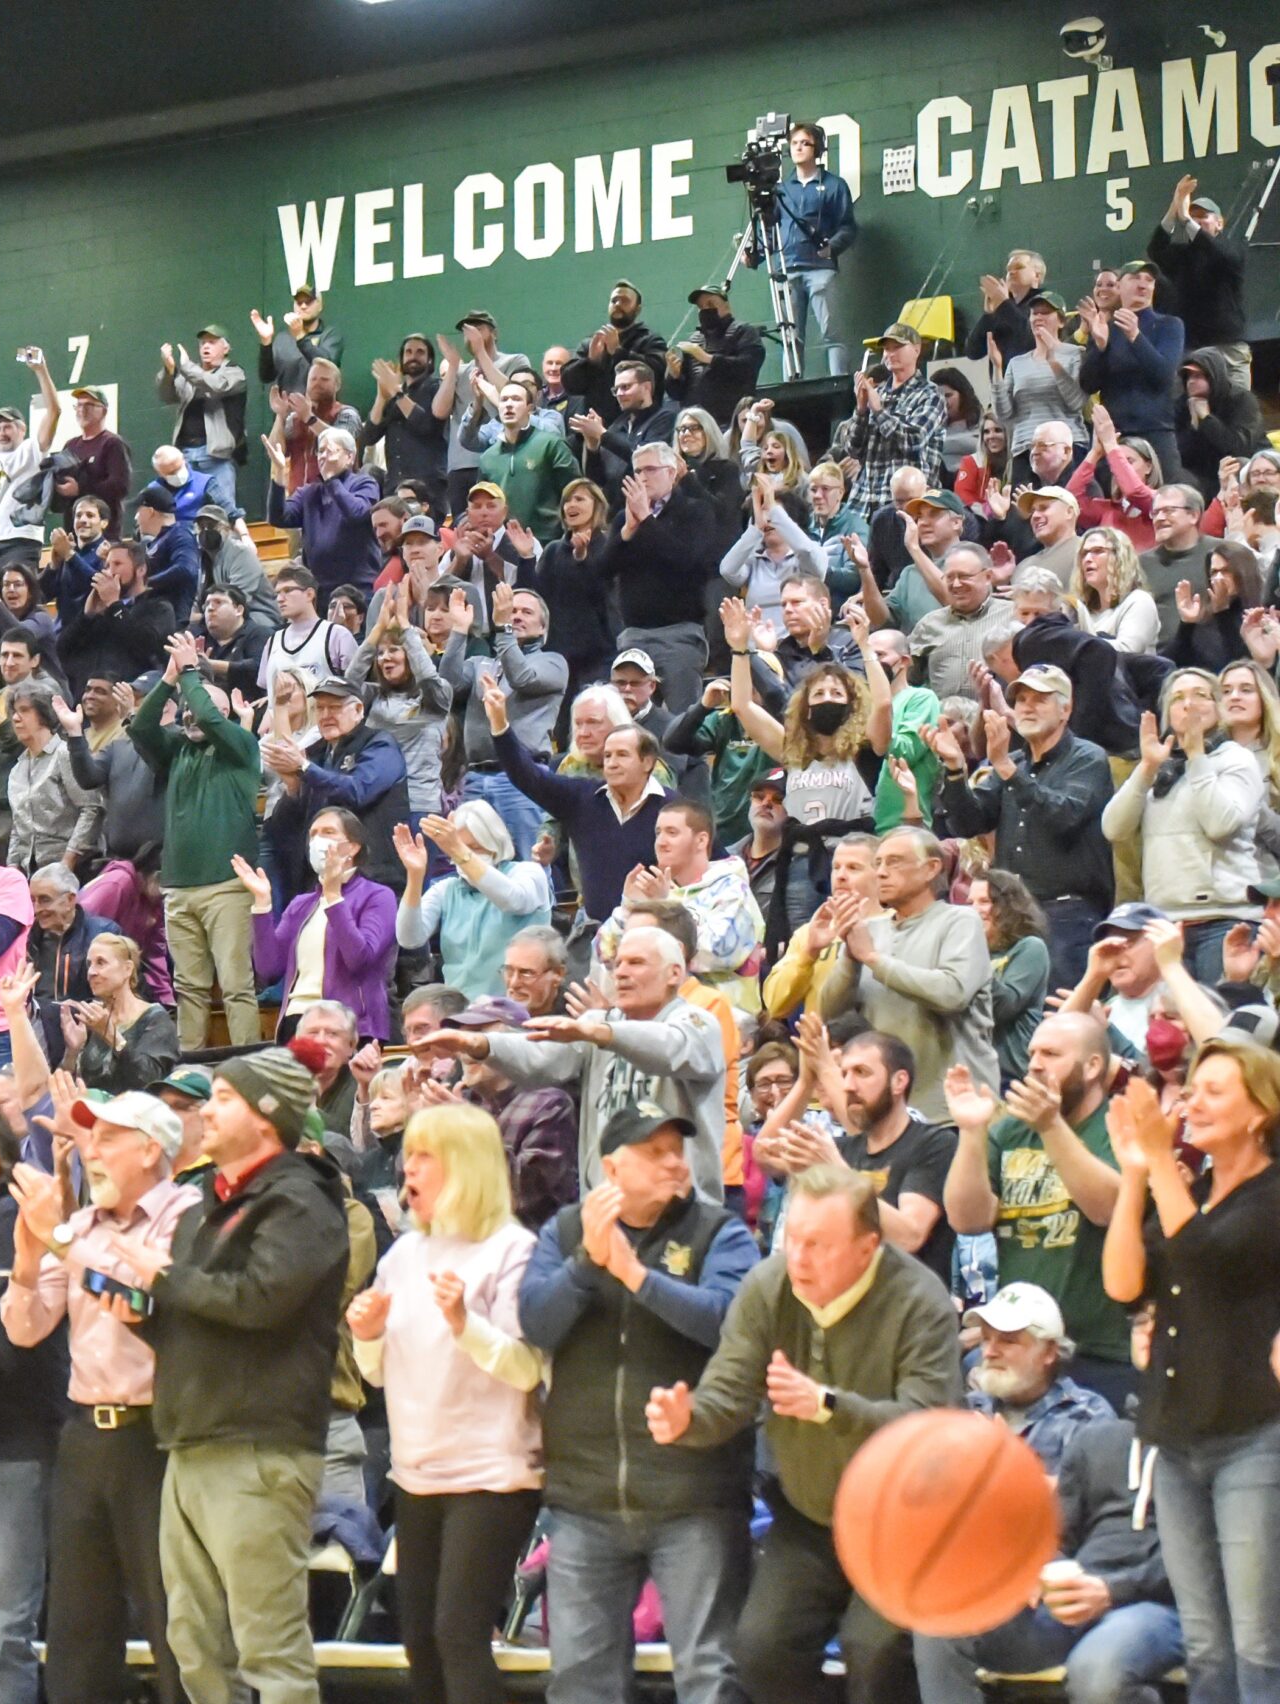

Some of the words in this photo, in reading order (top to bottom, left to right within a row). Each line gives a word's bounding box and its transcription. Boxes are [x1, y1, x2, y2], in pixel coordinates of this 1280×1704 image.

[278, 139, 694, 295] WELCOME
[1106, 178, 1134, 231] 5
[68, 335, 89, 384] 7
[789, 769, 854, 793] ERMONT
